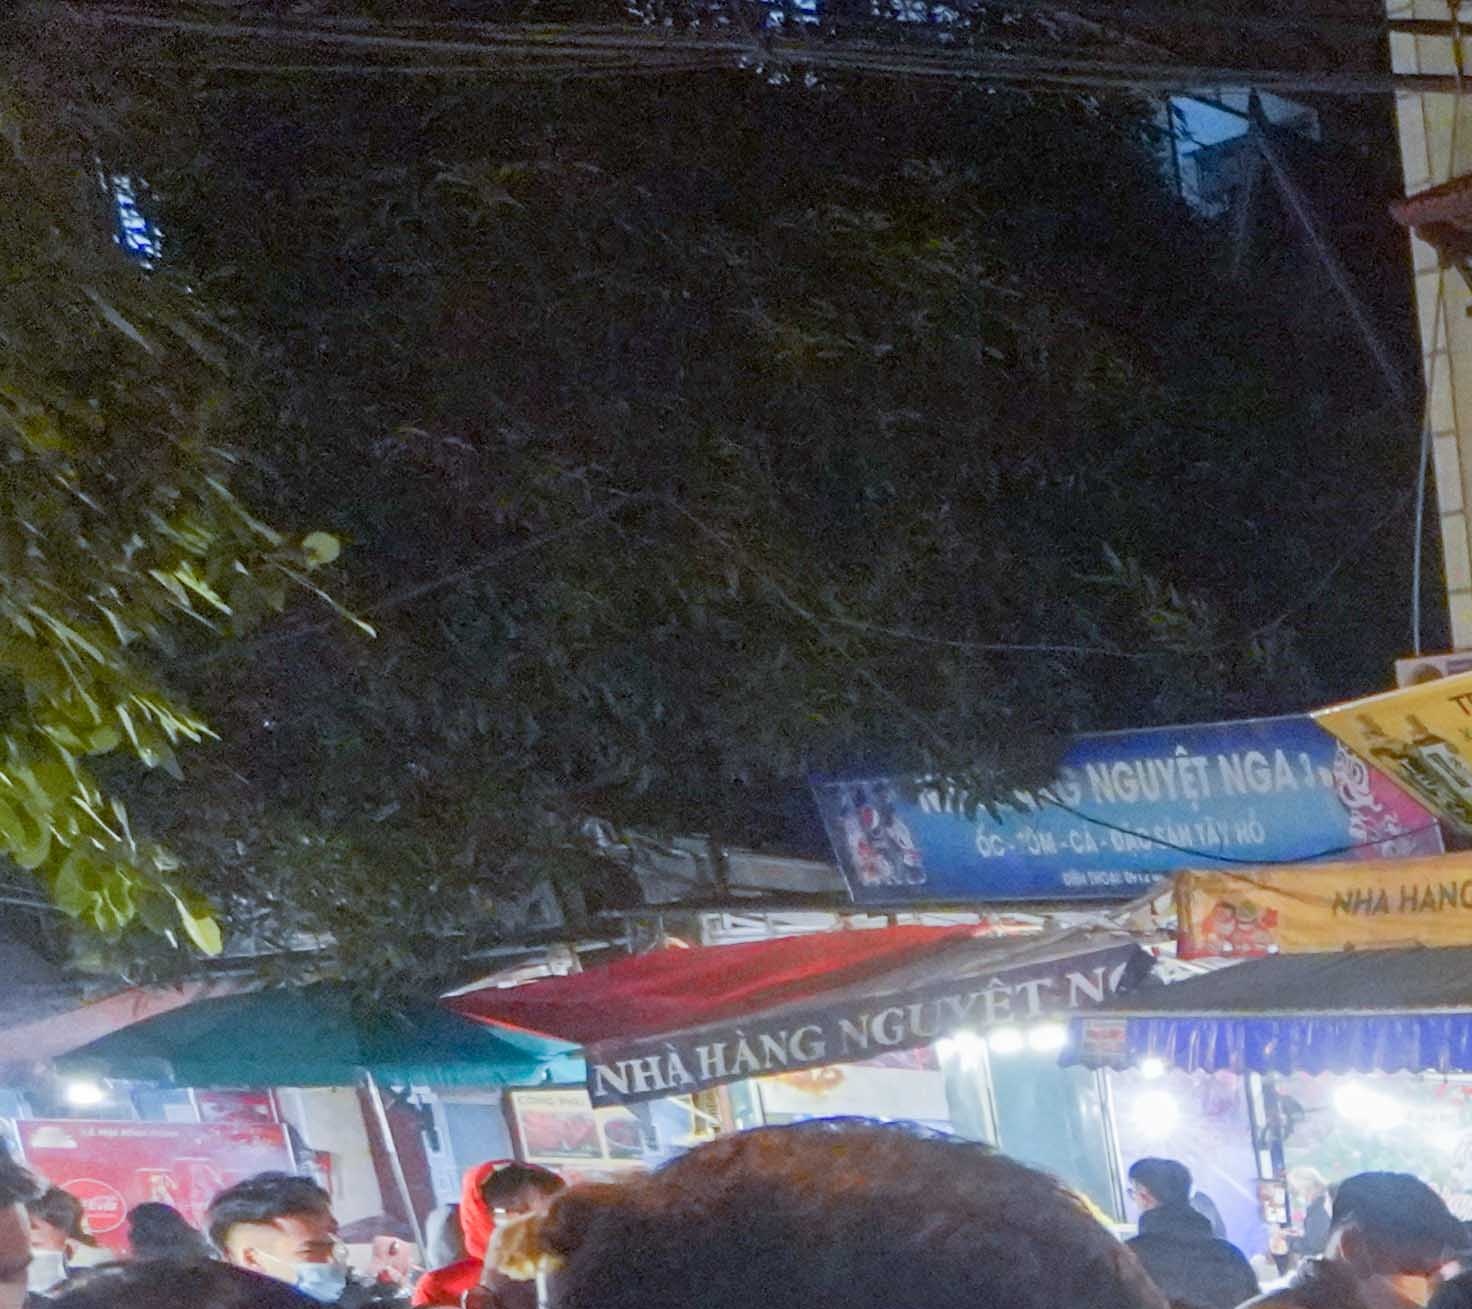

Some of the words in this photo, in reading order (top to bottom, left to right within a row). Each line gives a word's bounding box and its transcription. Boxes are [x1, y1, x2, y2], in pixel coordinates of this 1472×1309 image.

[1088, 745, 1209, 811] NGUYỆT
[1223, 749, 1294, 793] NGA
[592, 1042, 692, 1098] NHÀ
[696, 1017, 827, 1081] HÀNG
